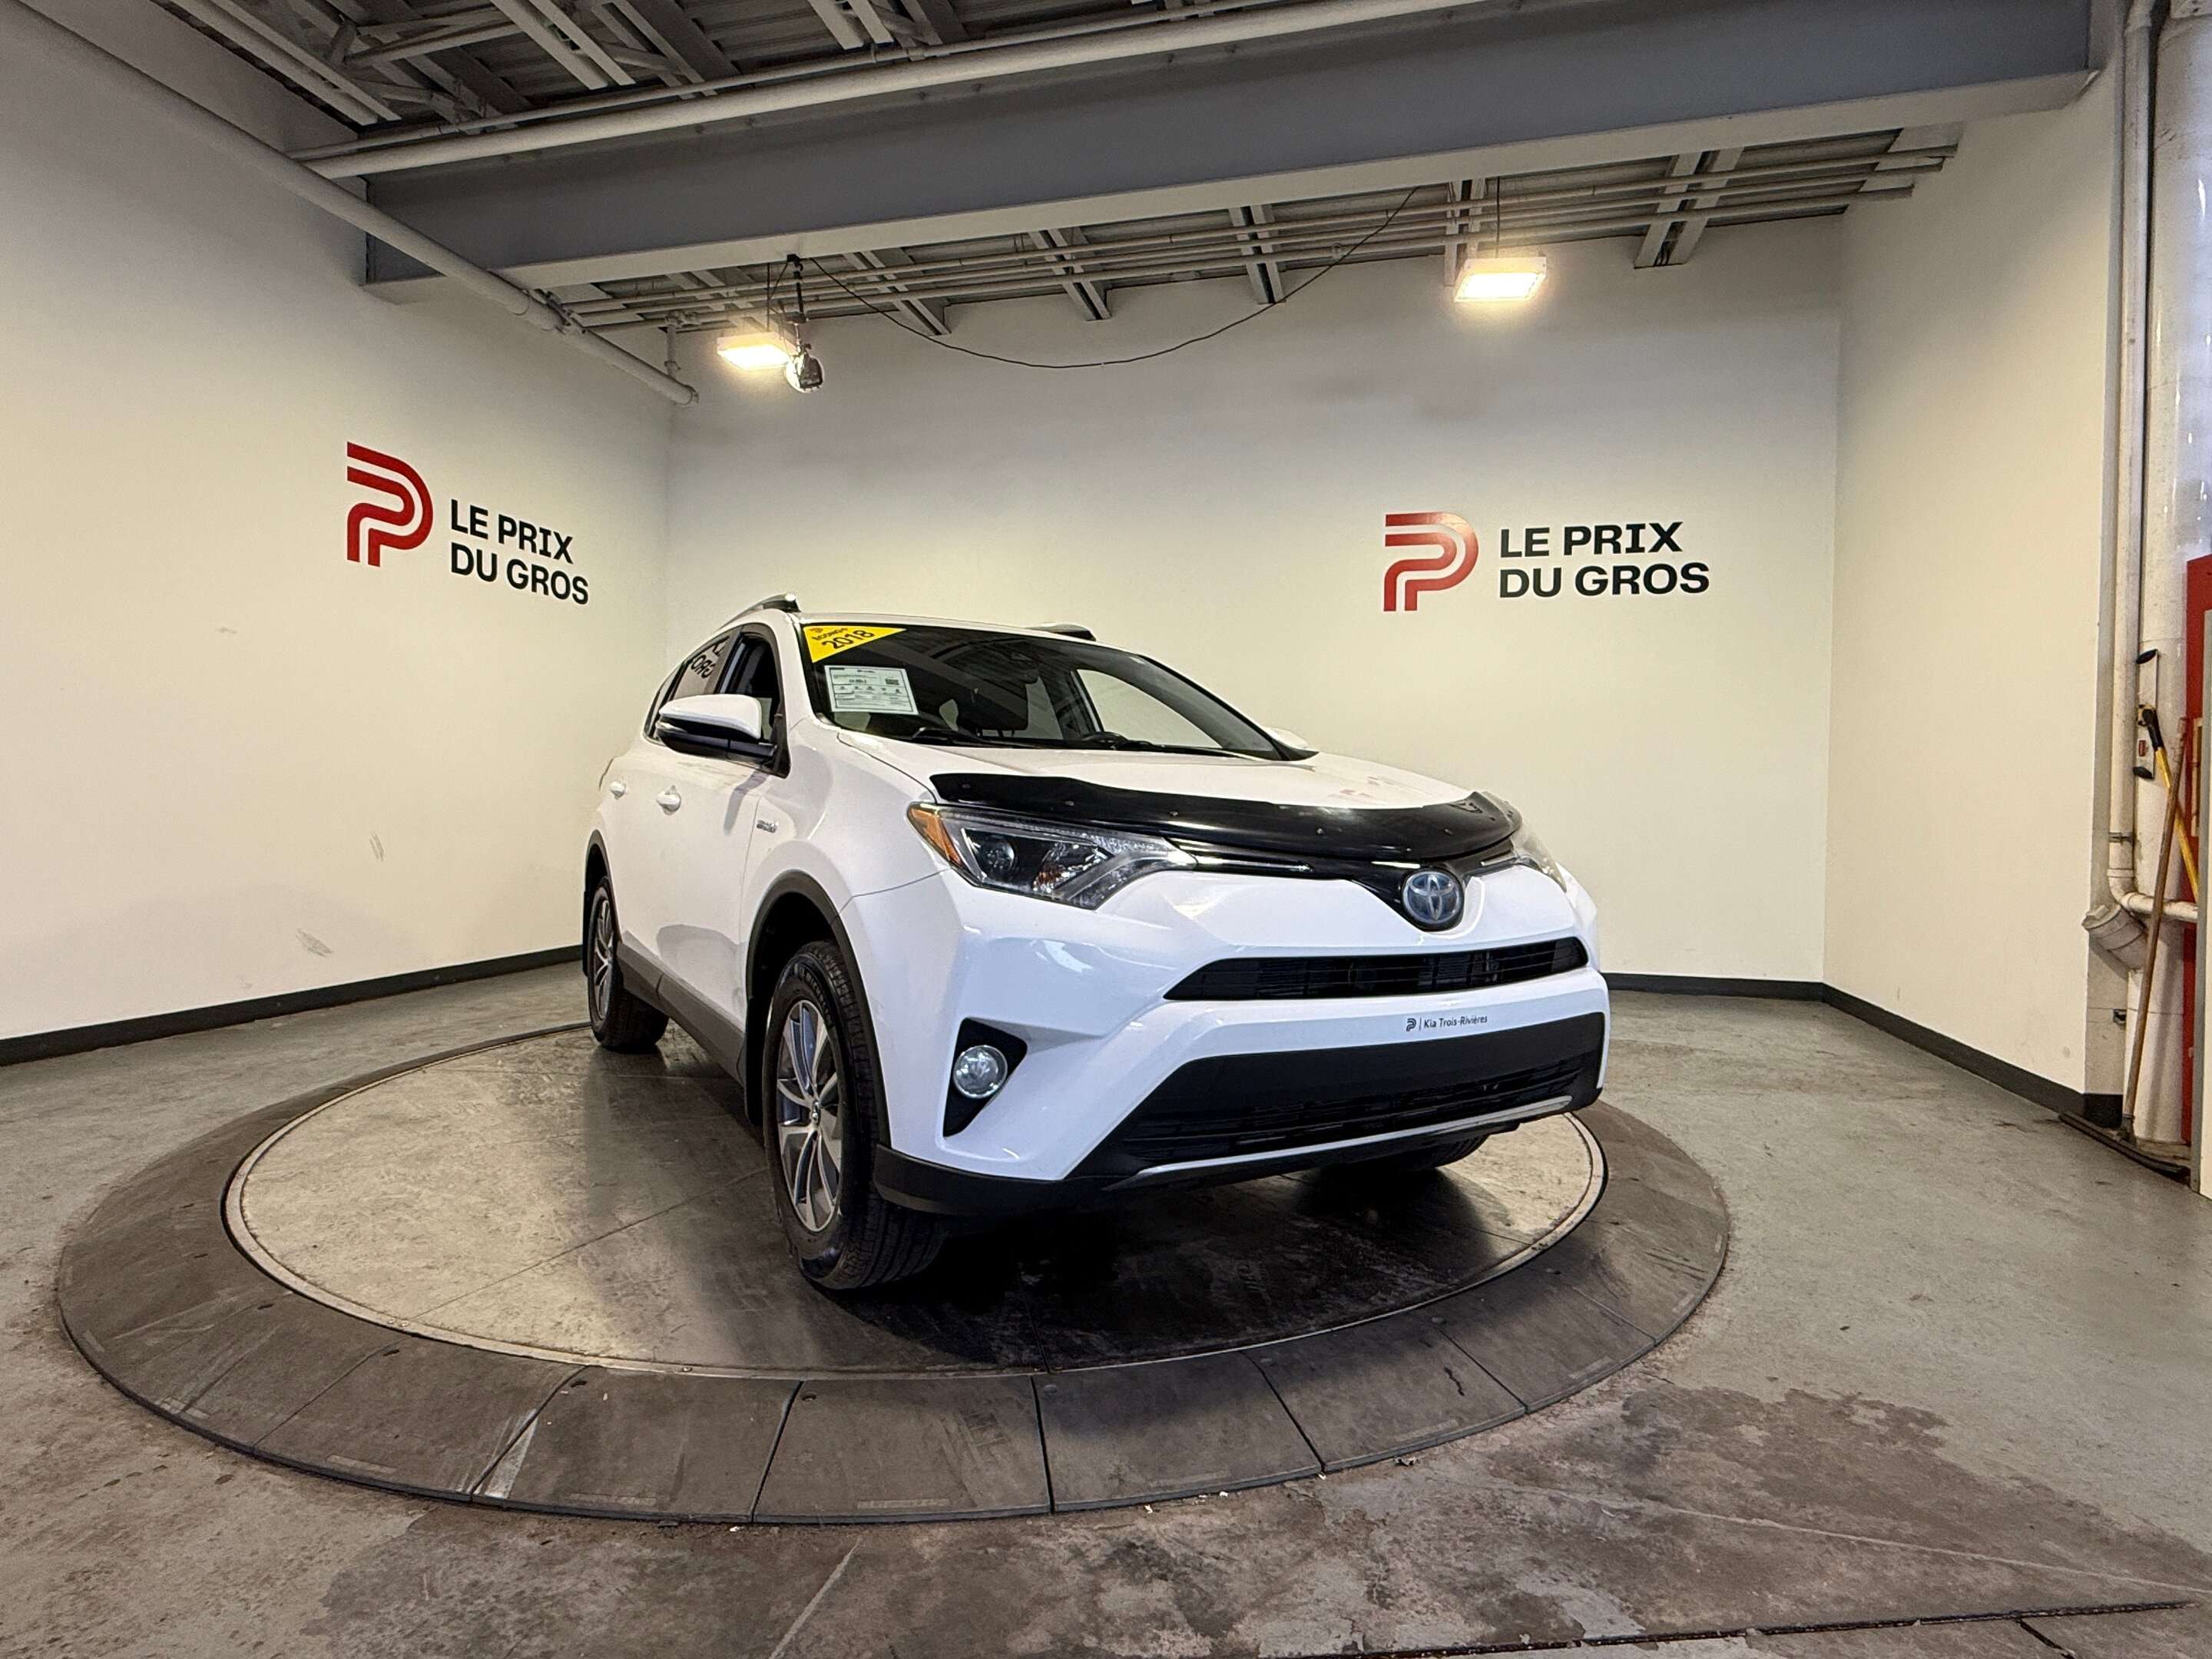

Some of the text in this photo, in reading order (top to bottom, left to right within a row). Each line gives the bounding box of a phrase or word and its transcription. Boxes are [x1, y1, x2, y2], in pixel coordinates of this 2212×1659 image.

[452, 499, 573, 564] LE PRIX
[1501, 522, 1683, 558] LE PRIX
[452, 542, 588, 604] DU GROS
[1500, 562, 1710, 598] DU GROS
[822, 630, 875, 649] 2018
[1424, 1019, 1436, 1028] Kia
[1439, 1015, 1488, 1027] Trois-Rivières
